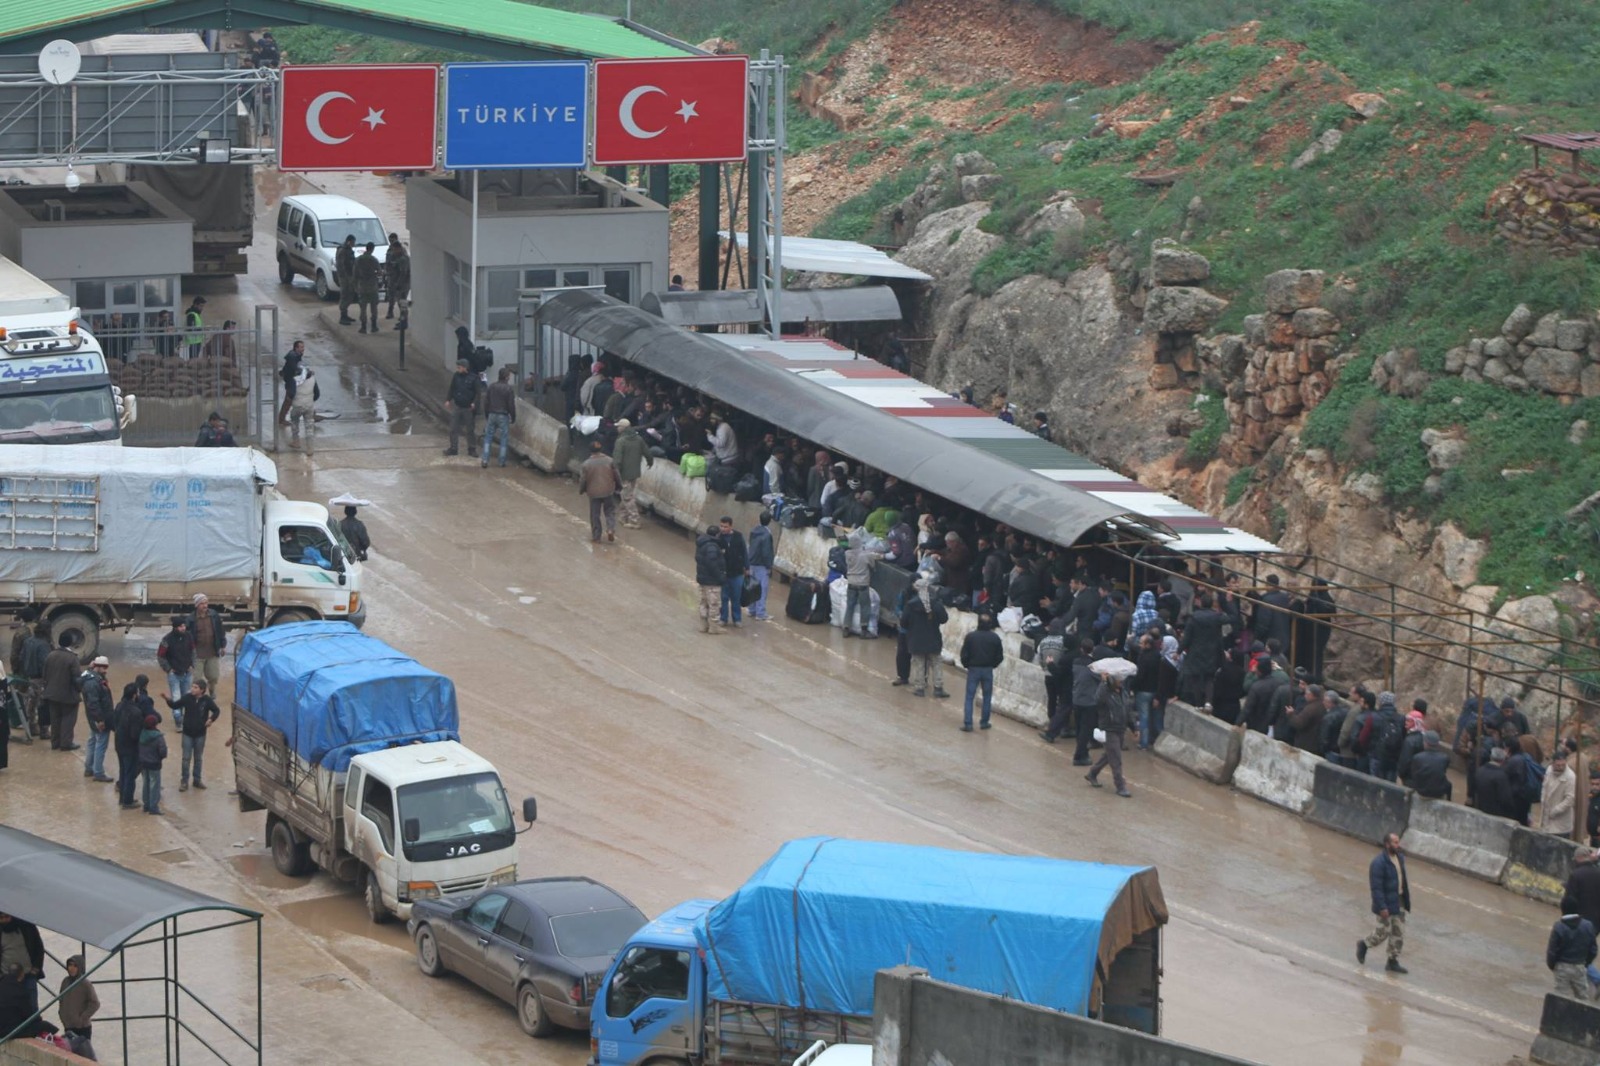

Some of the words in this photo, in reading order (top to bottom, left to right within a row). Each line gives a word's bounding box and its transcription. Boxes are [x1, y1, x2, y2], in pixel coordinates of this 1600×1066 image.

[457, 103, 577, 124] TÜRKİYE
[144, 501, 179, 510] UNHCR
[446, 843, 482, 857] JAC
